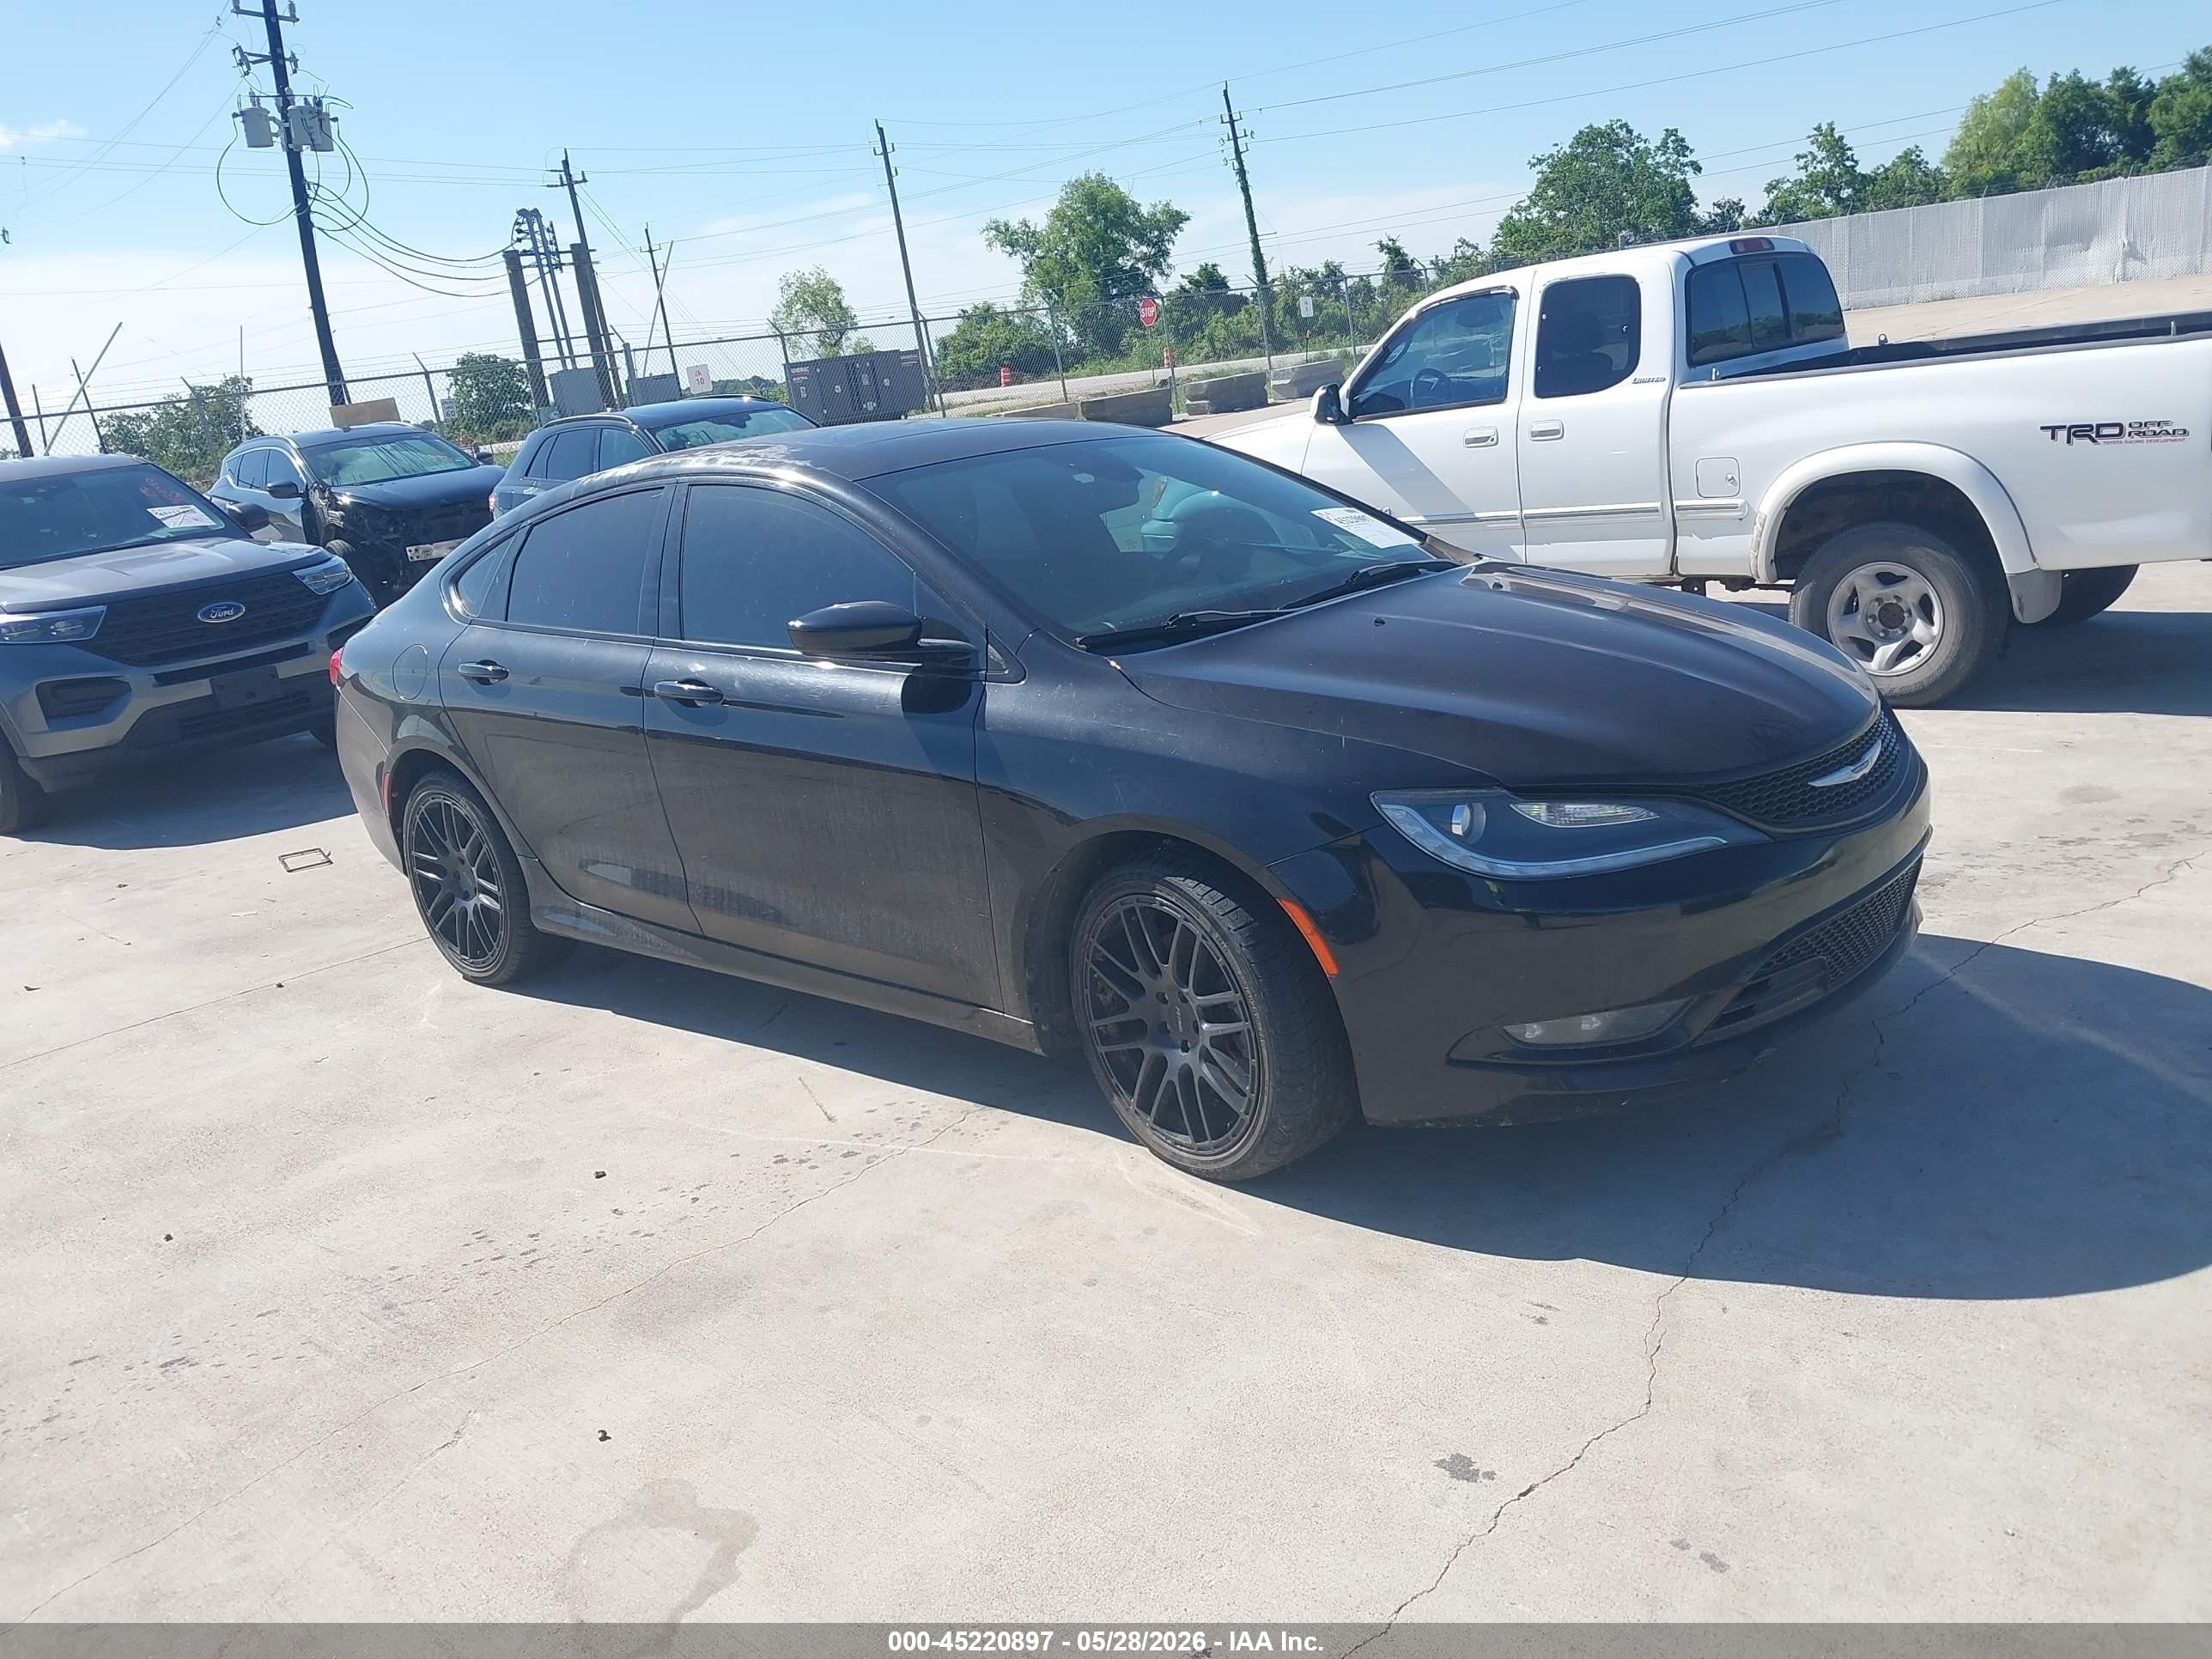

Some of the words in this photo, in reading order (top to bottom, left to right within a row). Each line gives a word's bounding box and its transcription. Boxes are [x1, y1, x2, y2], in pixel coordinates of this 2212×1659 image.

[1141, 307, 1155, 318] STOP
[696, 377, 705, 386] 10
[2039, 422, 2125, 446] TRD
[2128, 428, 2190, 439] ROAD
[210, 605, 234, 619] Ford
